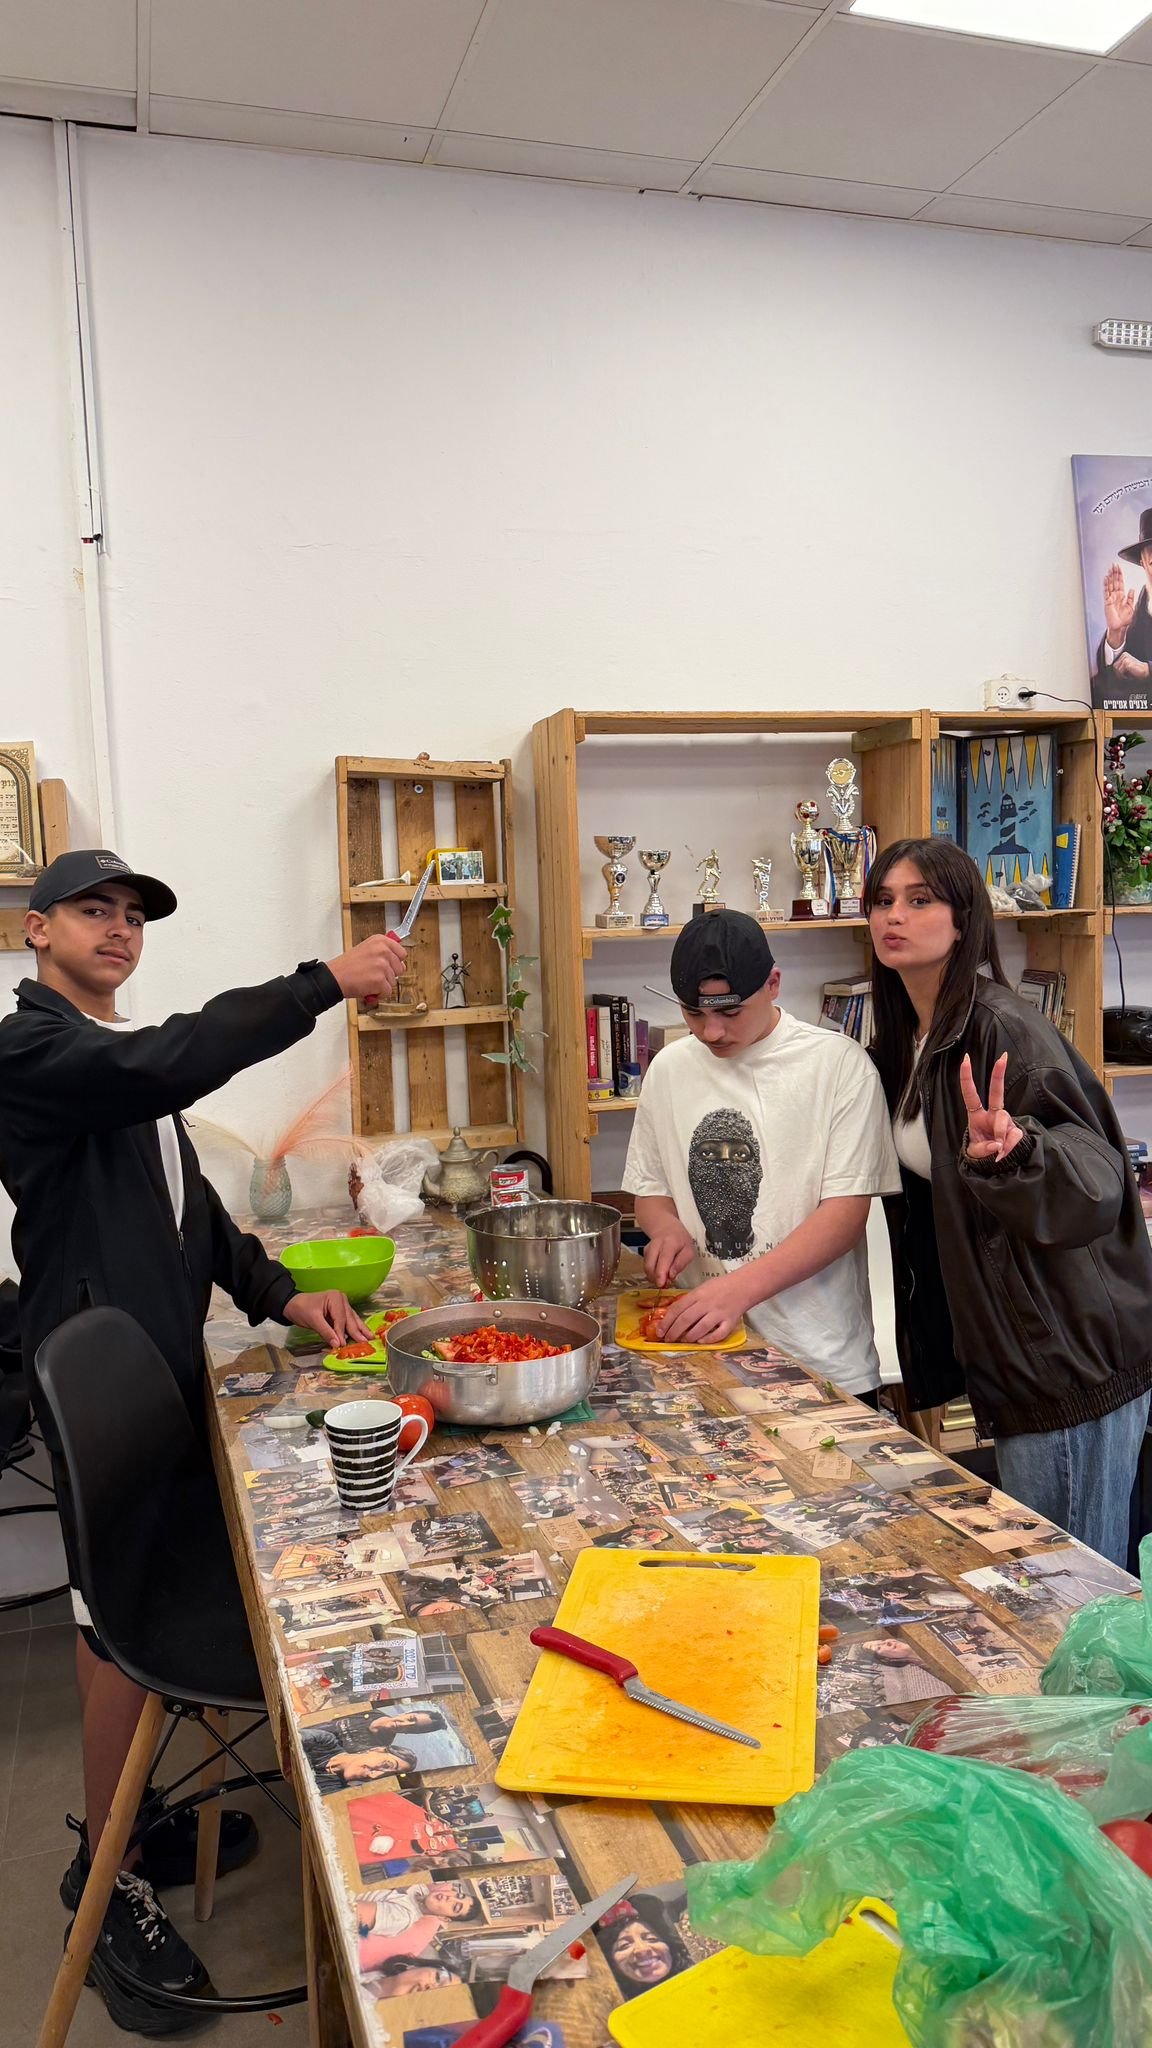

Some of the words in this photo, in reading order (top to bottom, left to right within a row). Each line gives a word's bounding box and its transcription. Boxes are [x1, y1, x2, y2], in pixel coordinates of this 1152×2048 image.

[1103, 488, 1123, 505] לעולם
[1092, 502, 1105, 513] ועד
[1103, 699, 1127, 709] אמיתיים
[1129, 699, 1148, 709] צבעים
